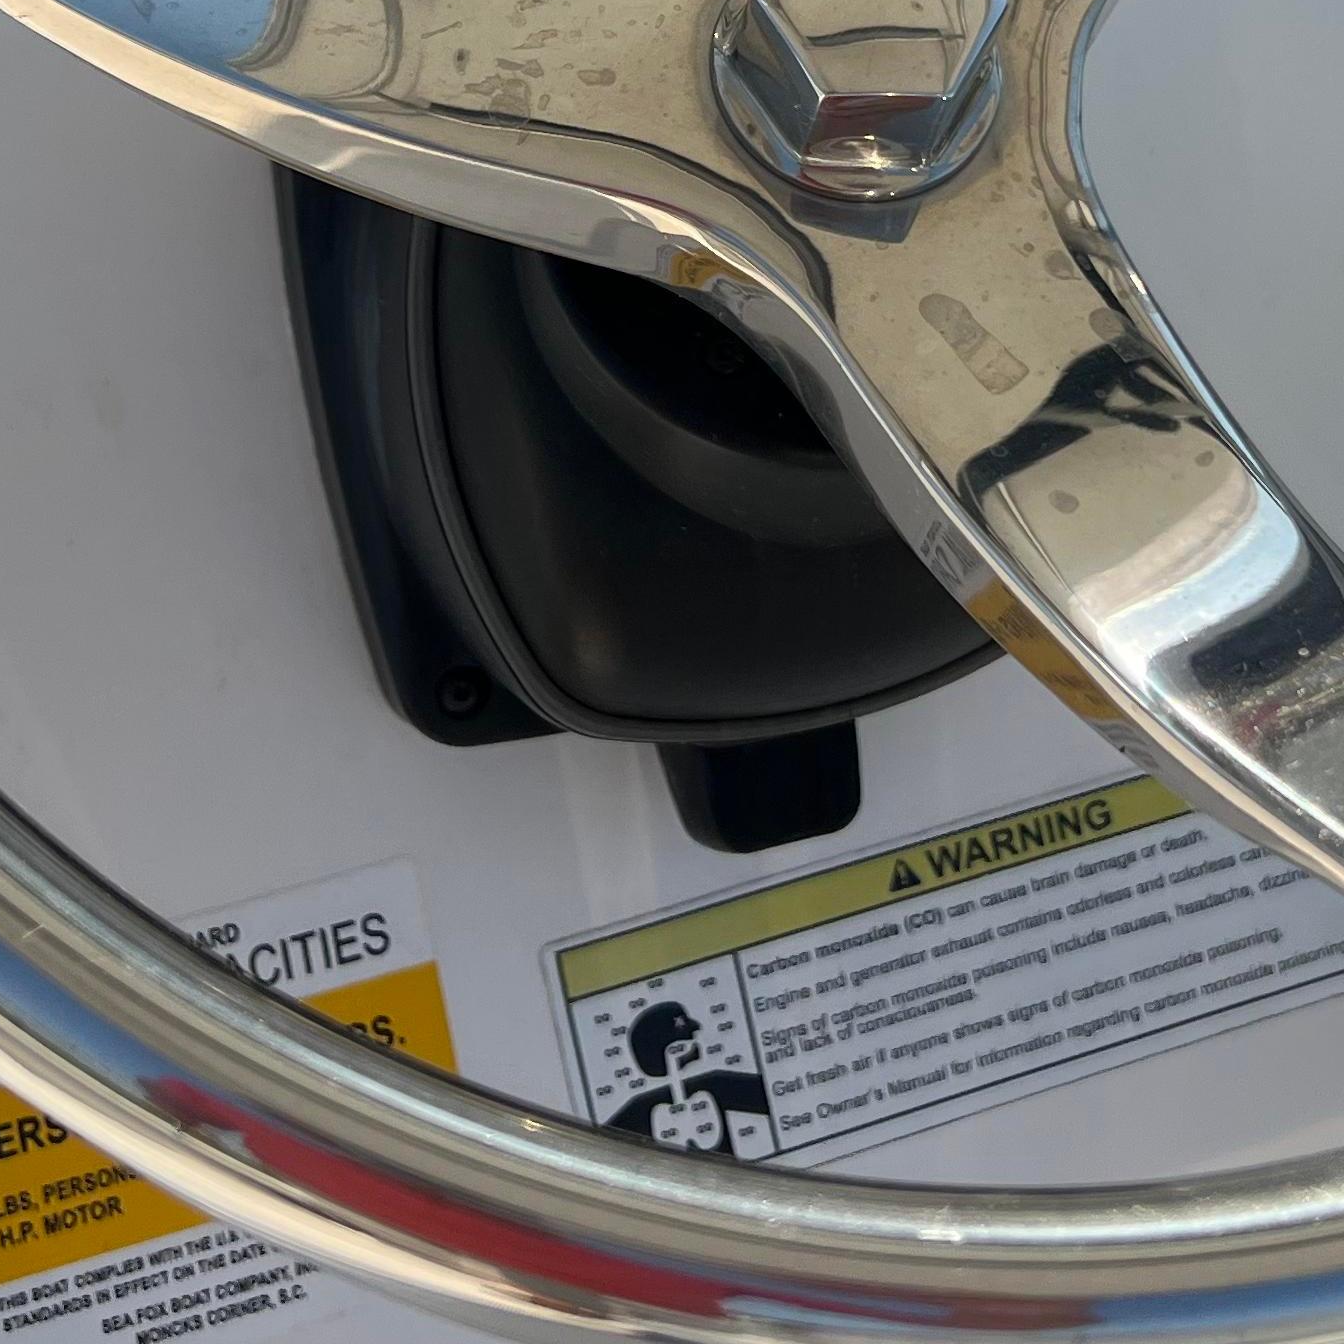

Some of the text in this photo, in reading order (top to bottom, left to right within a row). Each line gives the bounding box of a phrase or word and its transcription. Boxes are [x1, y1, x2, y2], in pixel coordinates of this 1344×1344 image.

[925, 799, 1113, 879] WARNING
[196, 921, 241, 948] ARD
[746, 827, 1208, 979] Carbon monoxide (CO) can cause brain damage or death.
[754, 985, 811, 1013] Engine
[814, 969, 848, 995] and
[849, 949, 927, 987] generator
[930, 926, 996, 958] exhaust
[996, 907, 1063, 939] contains
[1065, 885, 1132, 917] odorless
[1135, 874, 1166, 896] and
[1168, 854, 1237, 886] colorless
[761, 1022, 809, 1048] Signs
[811, 1012, 828, 1035] of
[830, 996, 890, 1025] carbon
[890, 971, 971, 1007] monoxide
[971, 947, 1048, 984] poisoning
[1051, 927, 1109, 957] include
[1110, 909, 1172, 938] nausea,
[1175, 883, 1256, 918] headache,
[764, 1041, 797, 1064] and
[799, 1031, 835, 1054] lack
[836, 1022, 855, 1042] of
[772, 926, 1284, 1098] Get fresh air if anyone shows signs of carbon monoxide poisoning.
[779, 1110, 814, 1133] See
[886, 1064, 949, 1097] Manual
[950, 1057, 974, 1076] for
[975, 1030, 1066, 1068] information
[1066, 1006, 1143, 1040] regarding
[1143, 987, 1199, 1014] carbon
[1200, 962, 1277, 996] monoxide
[42, 1165, 139, 1204] PERSON
[44, 1194, 124, 1236] MOTOR
[2, 1293, 93, 1333] STANDARDS
[112, 1268, 170, 1300] EFFECT
[171, 1262, 196, 1282] ON
[197, 1252, 227, 1274] THE
[229, 1242, 267, 1264] DATE
[30, 1278, 70, 1302] BOAT
[73, 1255, 146, 1289] COMPLIES
[148, 1244, 183, 1267] WITH
[184, 1234, 213, 1254] THE
[101, 1312, 135, 1335] SEA
[135, 1300, 170, 1325] FOX
[169, 1288, 212, 1314] BOAT
